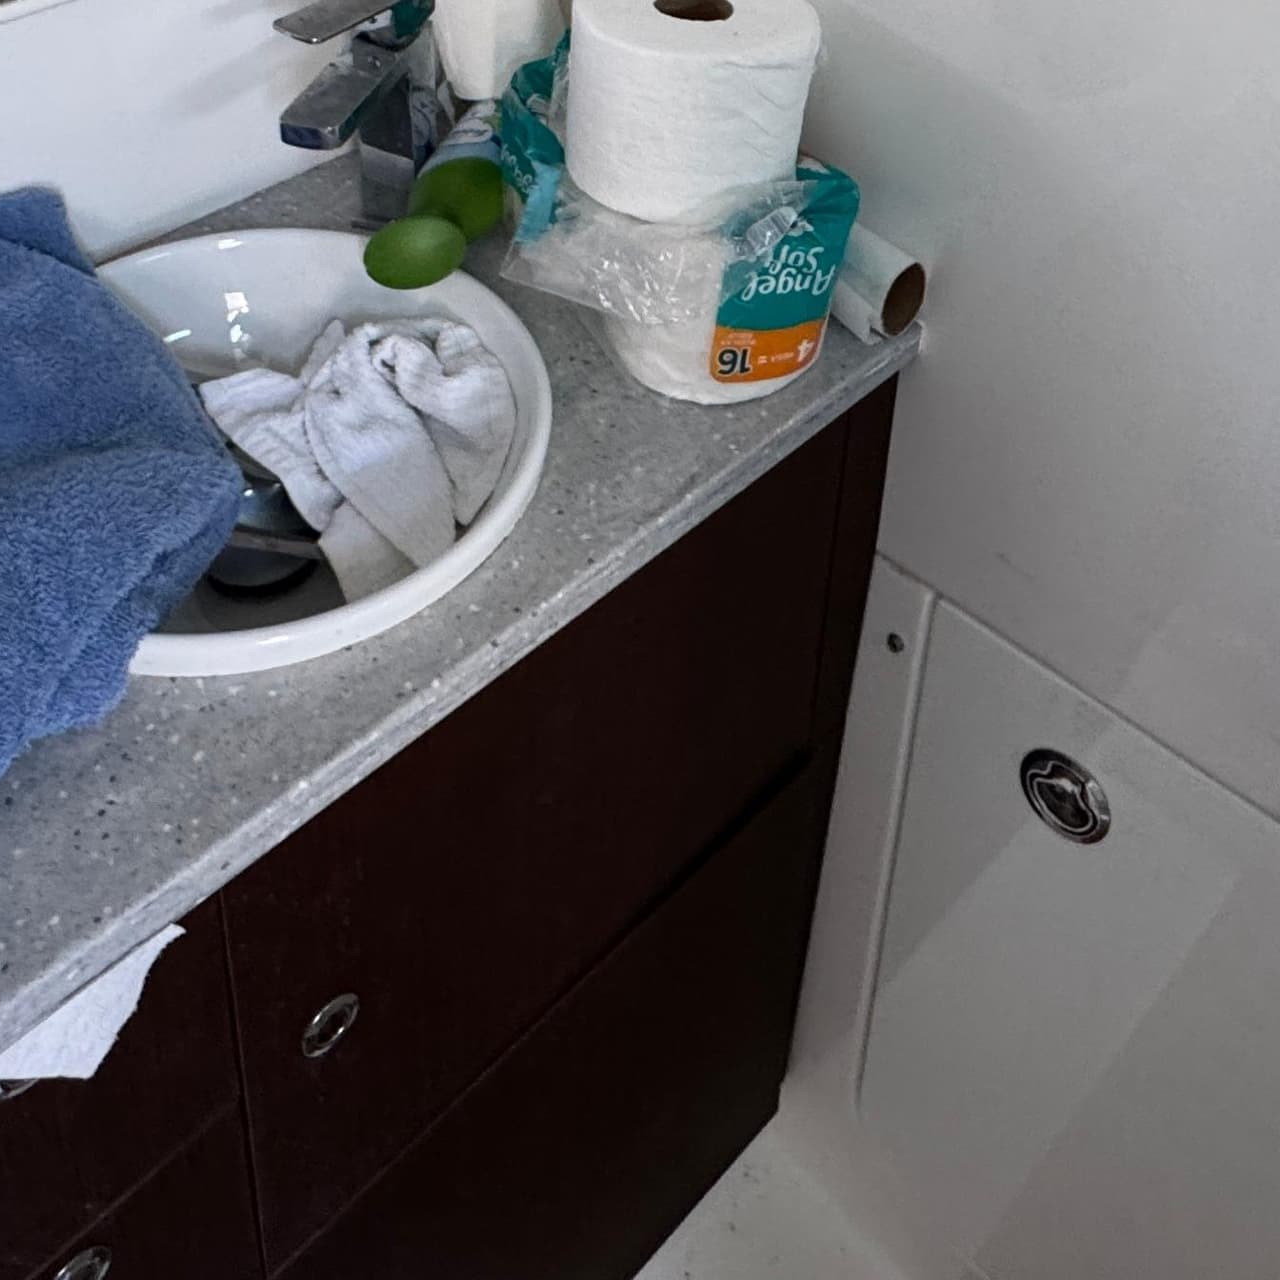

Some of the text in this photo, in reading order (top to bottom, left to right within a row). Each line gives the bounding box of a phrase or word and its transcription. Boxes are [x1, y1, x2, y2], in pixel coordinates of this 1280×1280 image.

[741, 264, 836, 301] Angel
[717, 339, 815, 375] 4 16
